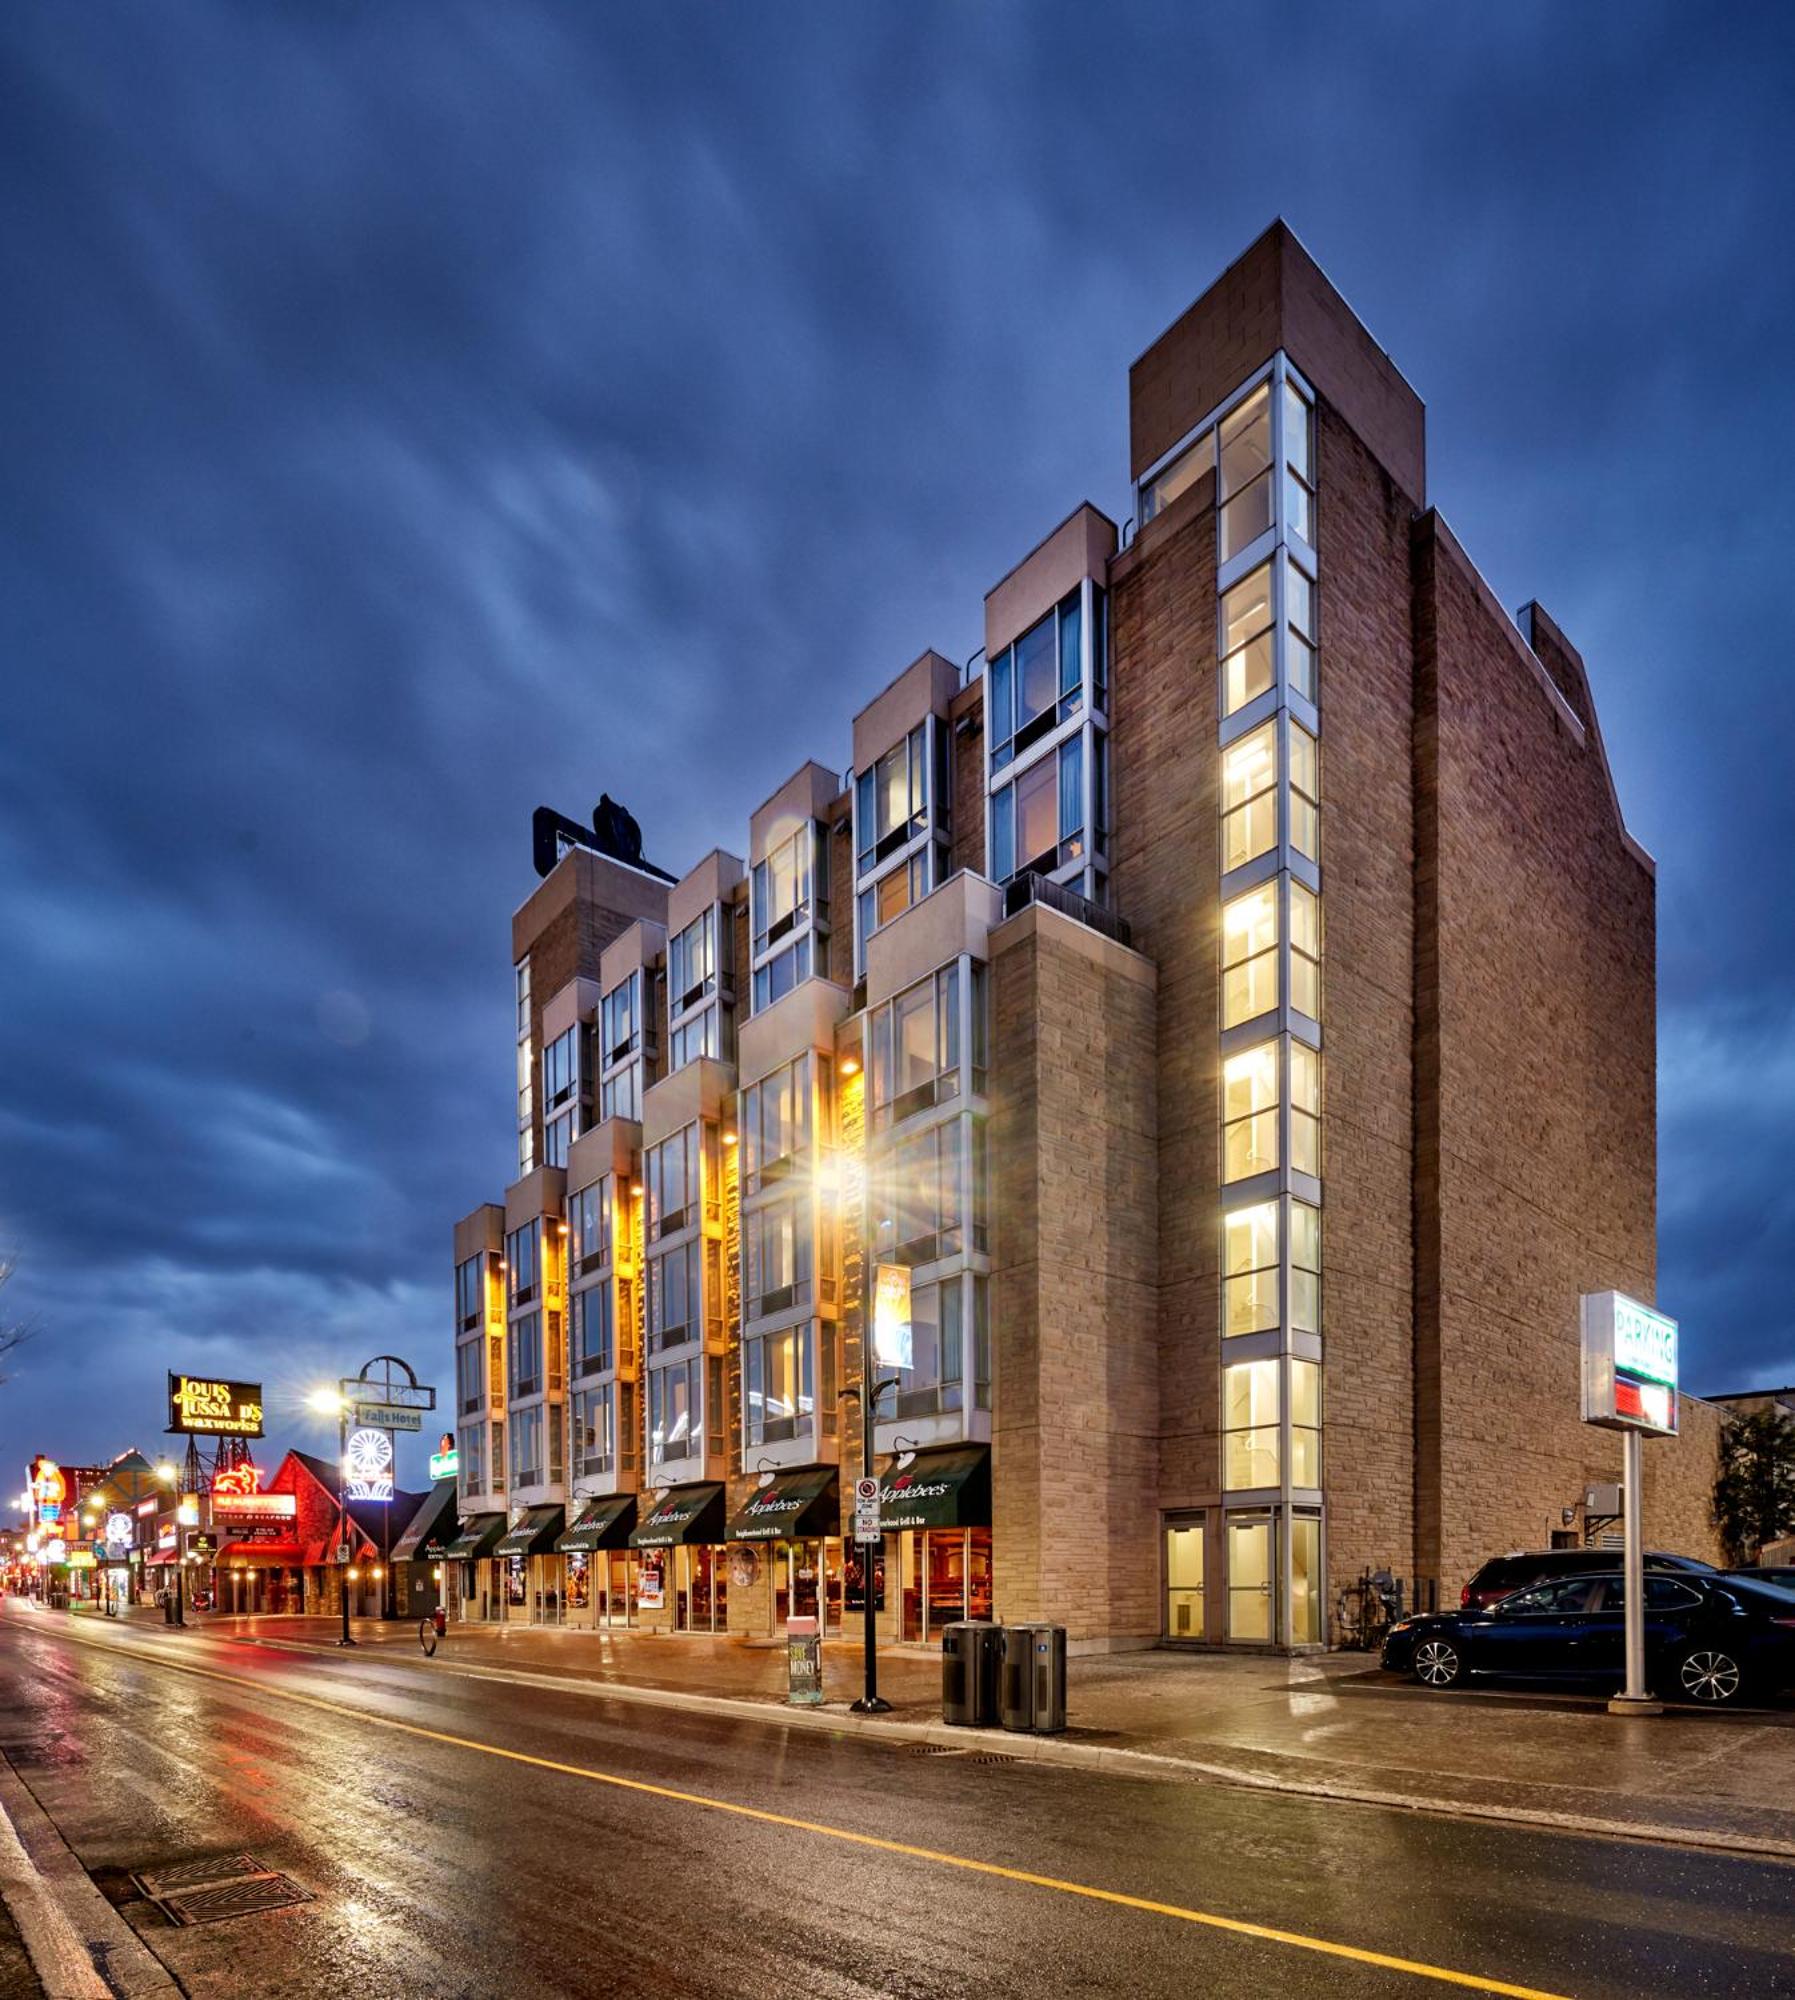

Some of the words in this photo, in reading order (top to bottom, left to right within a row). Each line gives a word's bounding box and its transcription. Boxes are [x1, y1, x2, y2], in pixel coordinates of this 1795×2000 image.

[179, 1376, 231, 1404] LOUIS
[173, 1393, 263, 1422] TUSSAD'S
[365, 1409, 390, 1424] Falls
[392, 1412, 421, 1425] Hotel
